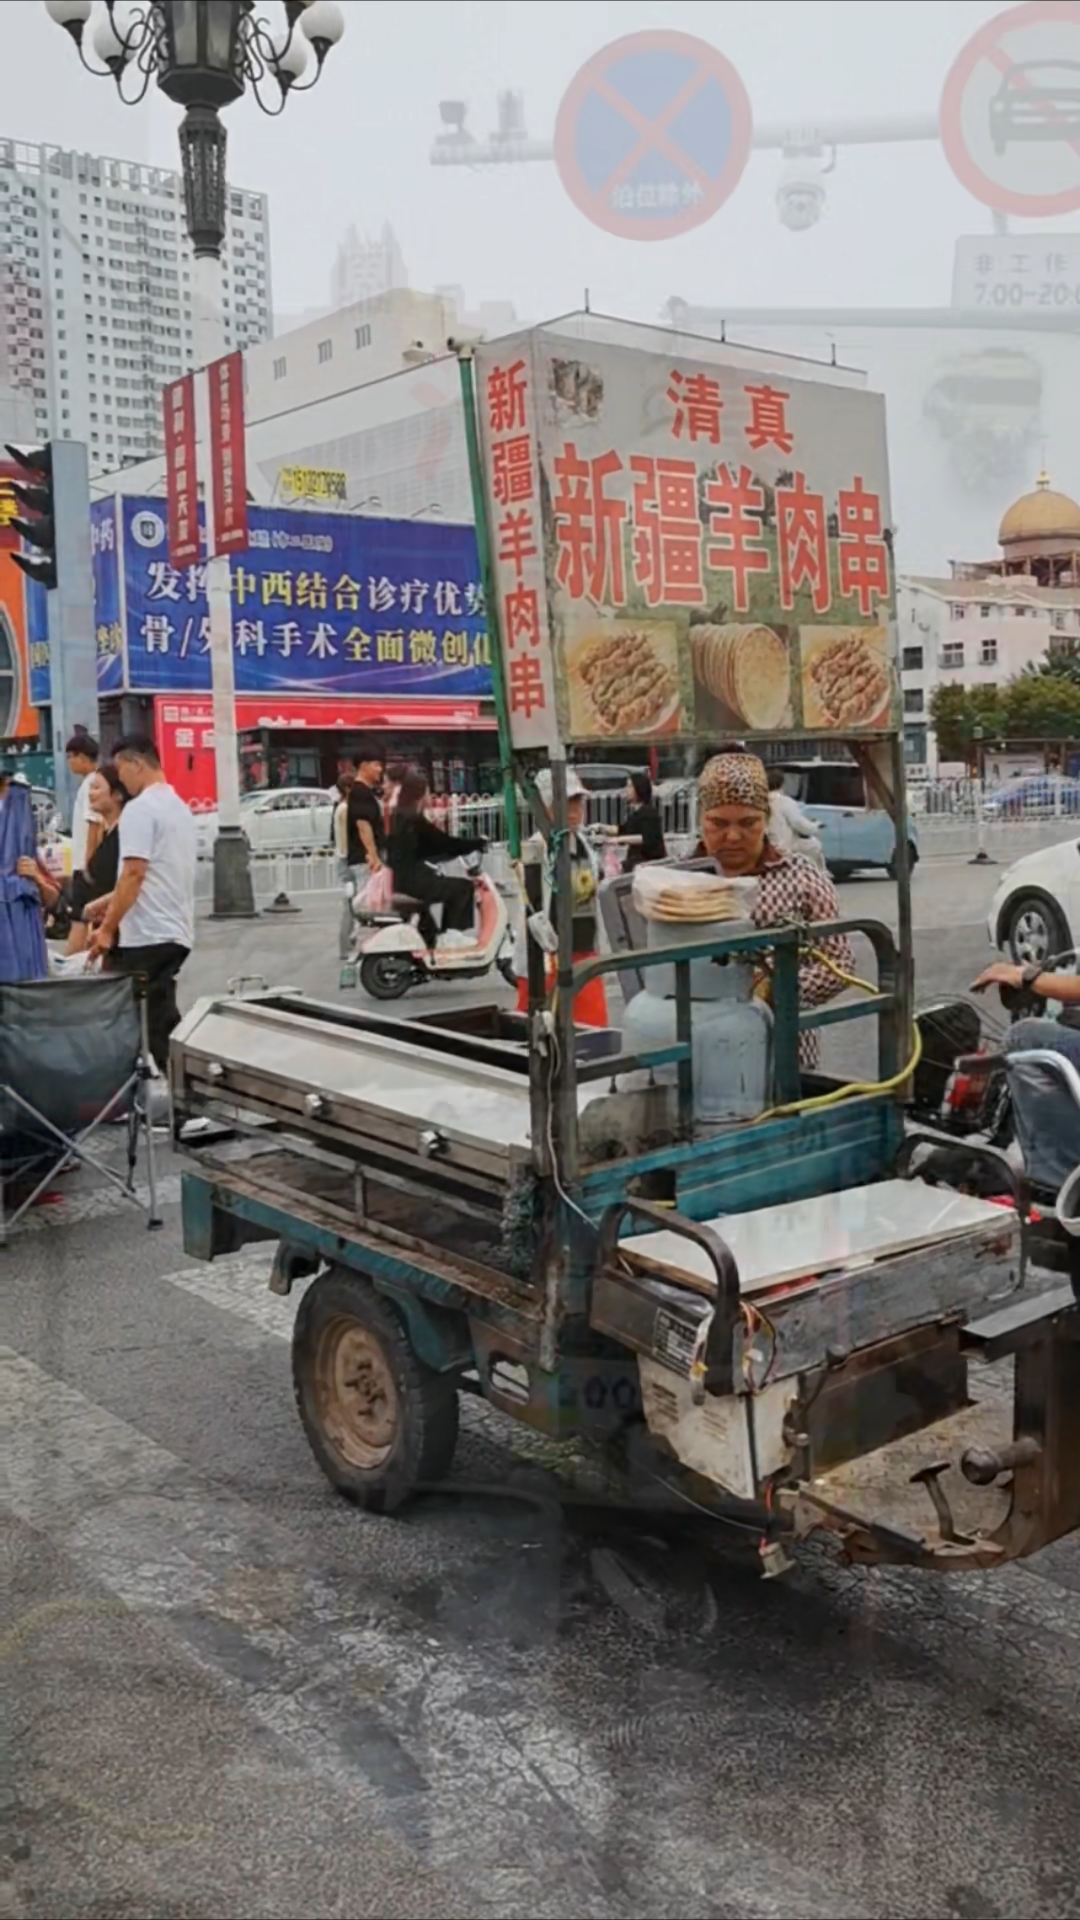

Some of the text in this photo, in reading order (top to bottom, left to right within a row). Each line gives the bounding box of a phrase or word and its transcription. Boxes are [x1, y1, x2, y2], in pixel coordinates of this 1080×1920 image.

[974, 252, 1069, 274] 非工作
[667, 369, 794, 455] 清真
[488, 359, 546, 719] 新疆羊肉串
[552, 442, 890, 616] 新疆羊肉串
